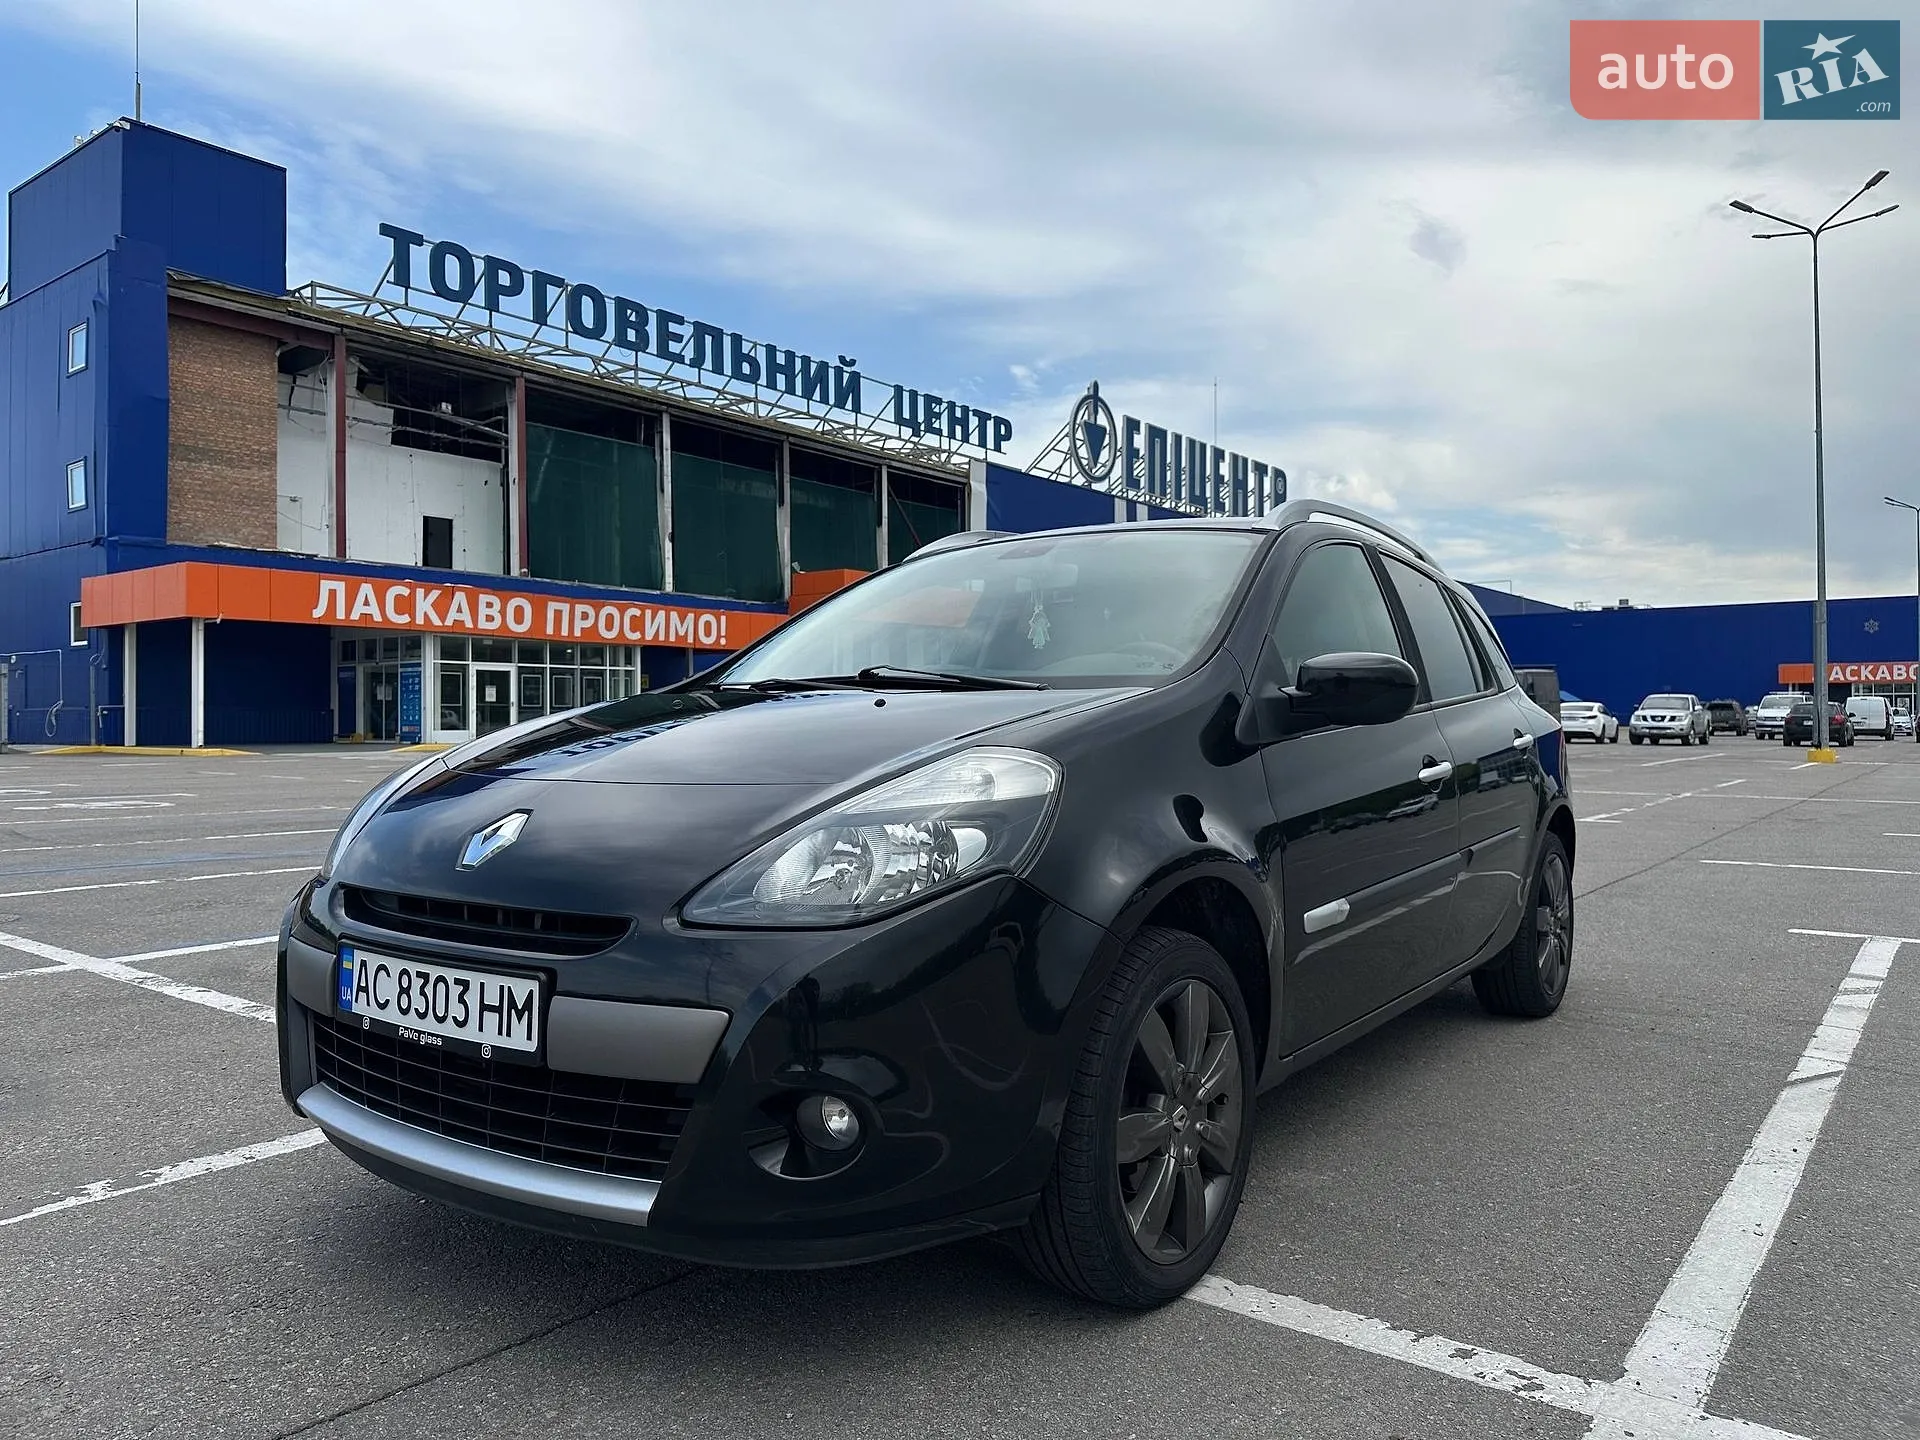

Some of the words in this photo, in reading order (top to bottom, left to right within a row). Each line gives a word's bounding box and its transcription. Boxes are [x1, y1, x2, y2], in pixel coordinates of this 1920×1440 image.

[379, 222, 862, 412] ТОРГОВЕЛЬНИЙ
[893, 383, 1013, 452] ЦЕНТР
[1122, 414, 1288, 518] ЕПІЦЕНТР
[312, 580, 533, 635] ЛАСКАВО
[545, 601, 727, 645] ПРОСИМО!
[1812, 664, 1919, 681] АСКАВО
[341, 985, 352, 1001] UA
[419, 1032, 442, 1046] glass
